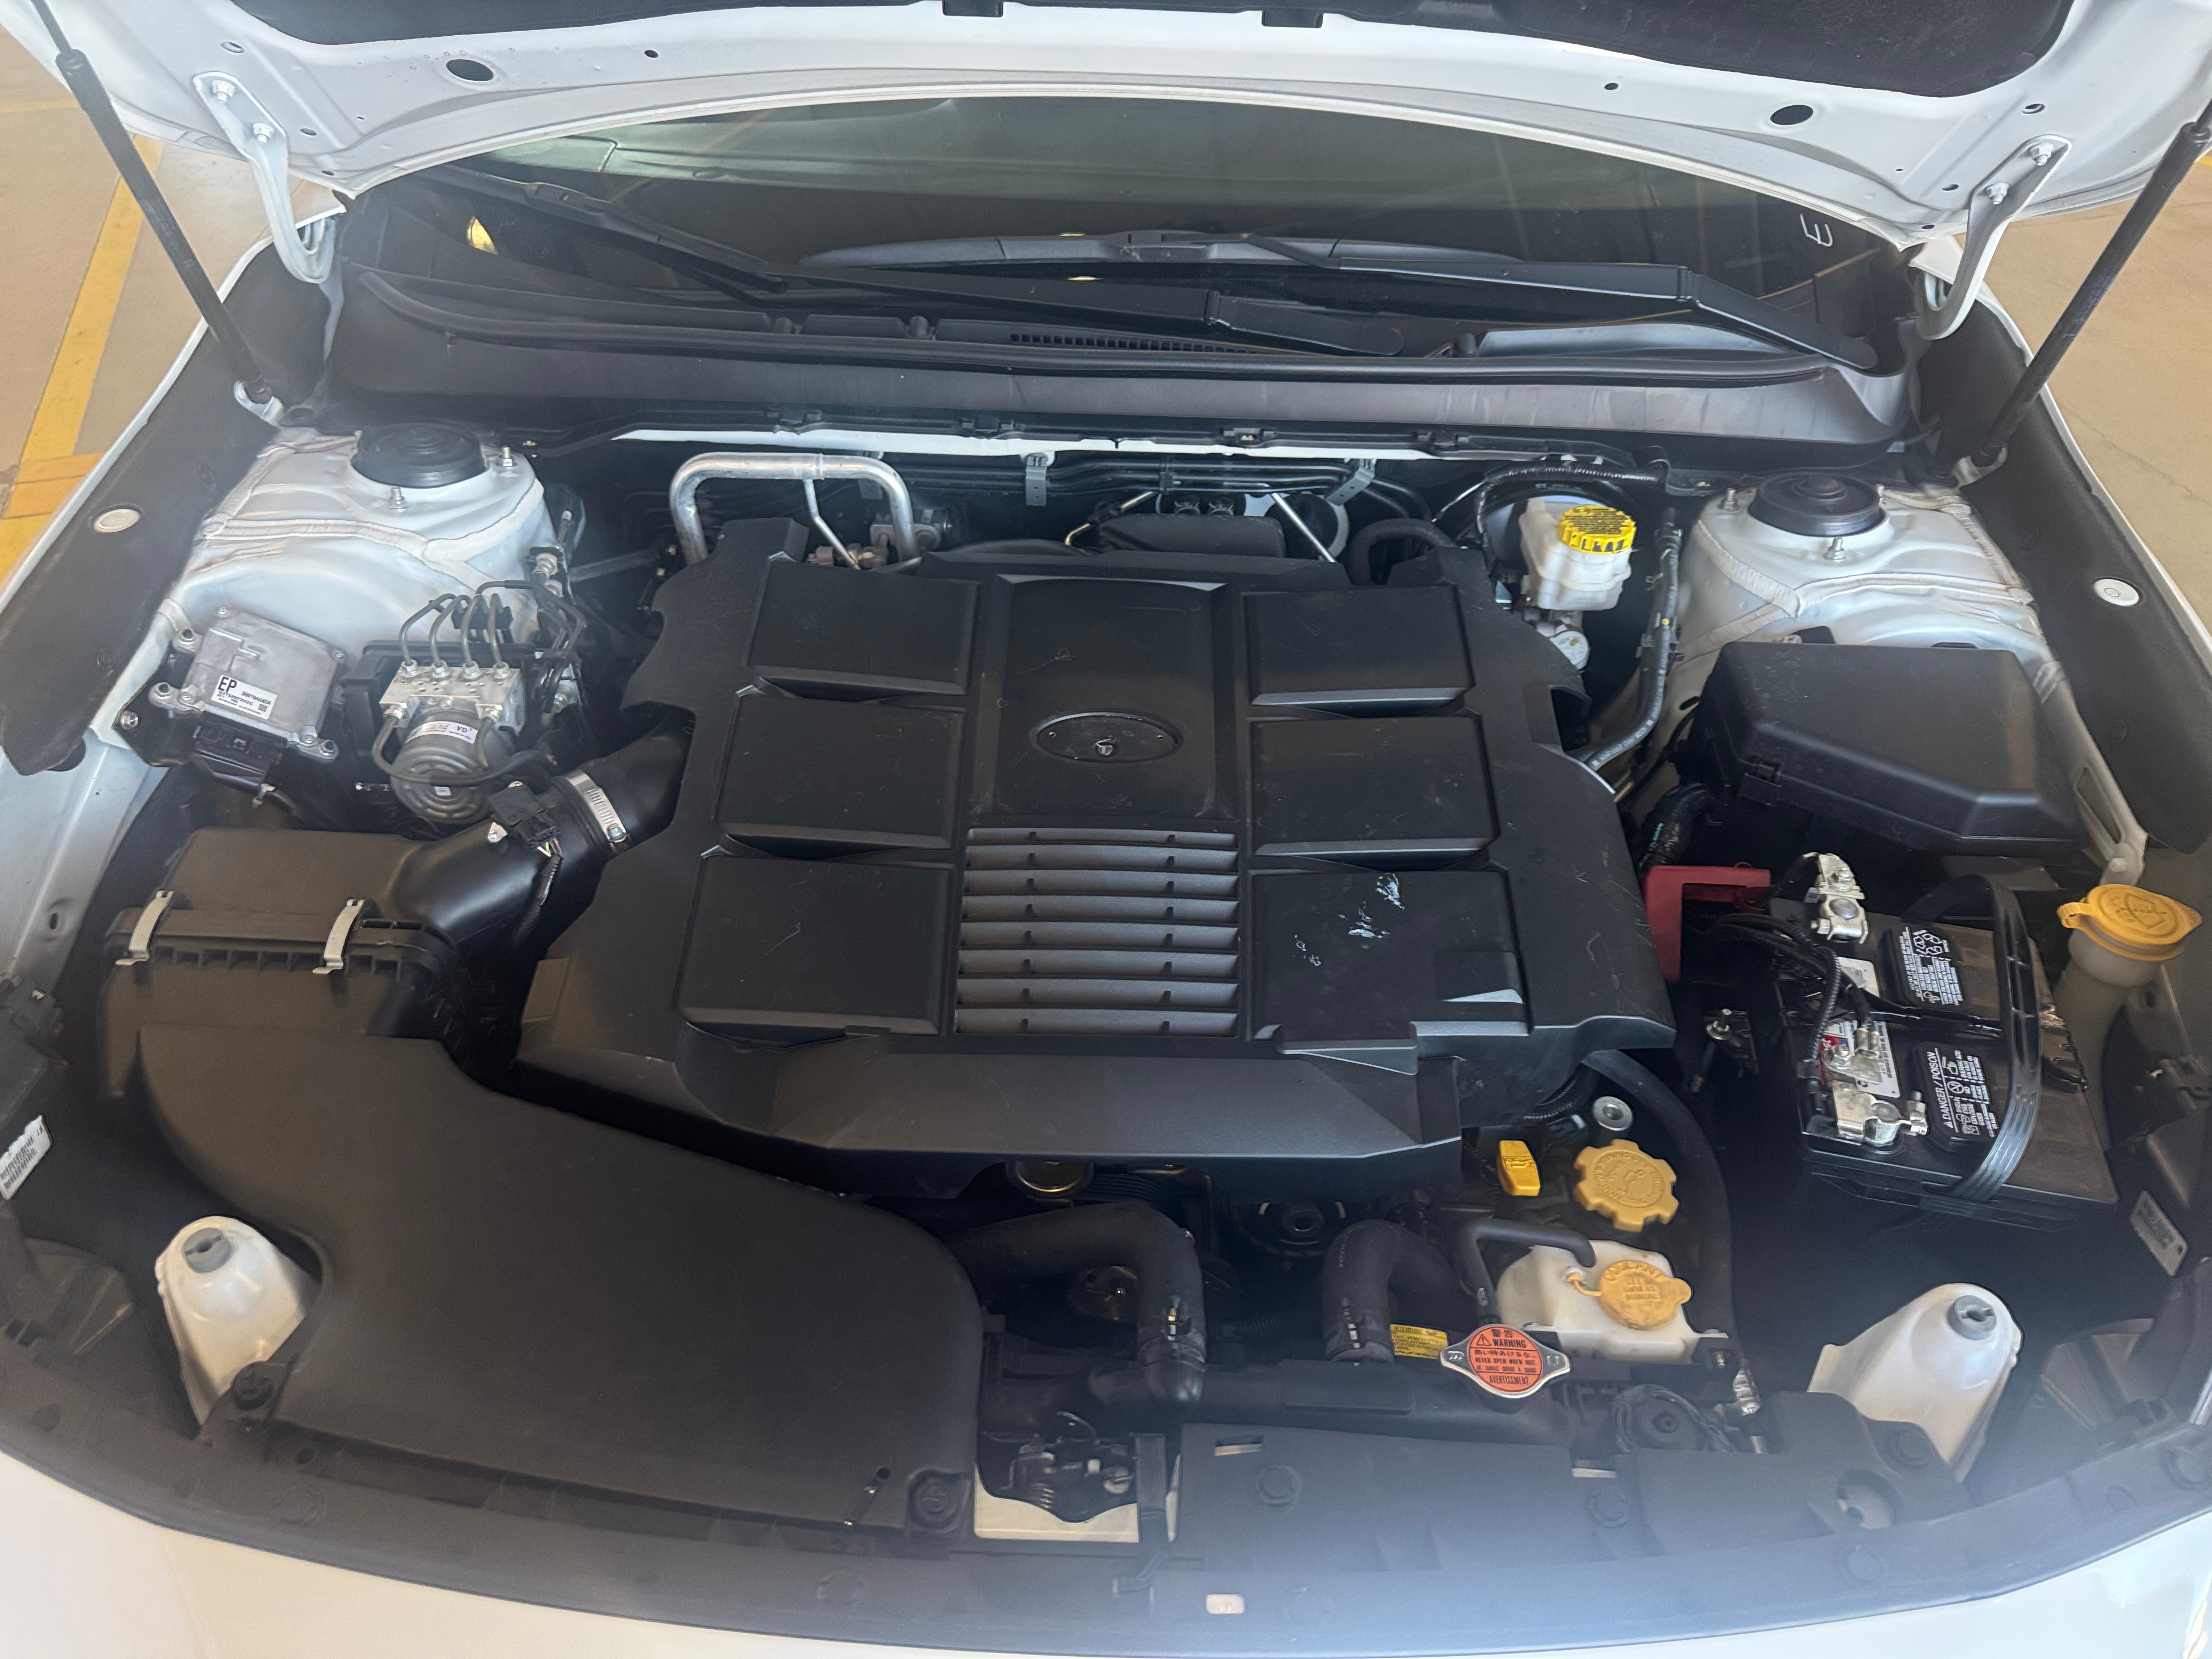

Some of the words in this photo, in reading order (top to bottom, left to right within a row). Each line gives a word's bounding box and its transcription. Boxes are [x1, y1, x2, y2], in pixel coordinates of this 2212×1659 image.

[218, 676, 238, 692] EP
[1927, 1051, 1942, 1080] POISON
[1936, 1087, 1952, 1120] DANGER
[1492, 1339, 1527, 1348] WARNING
